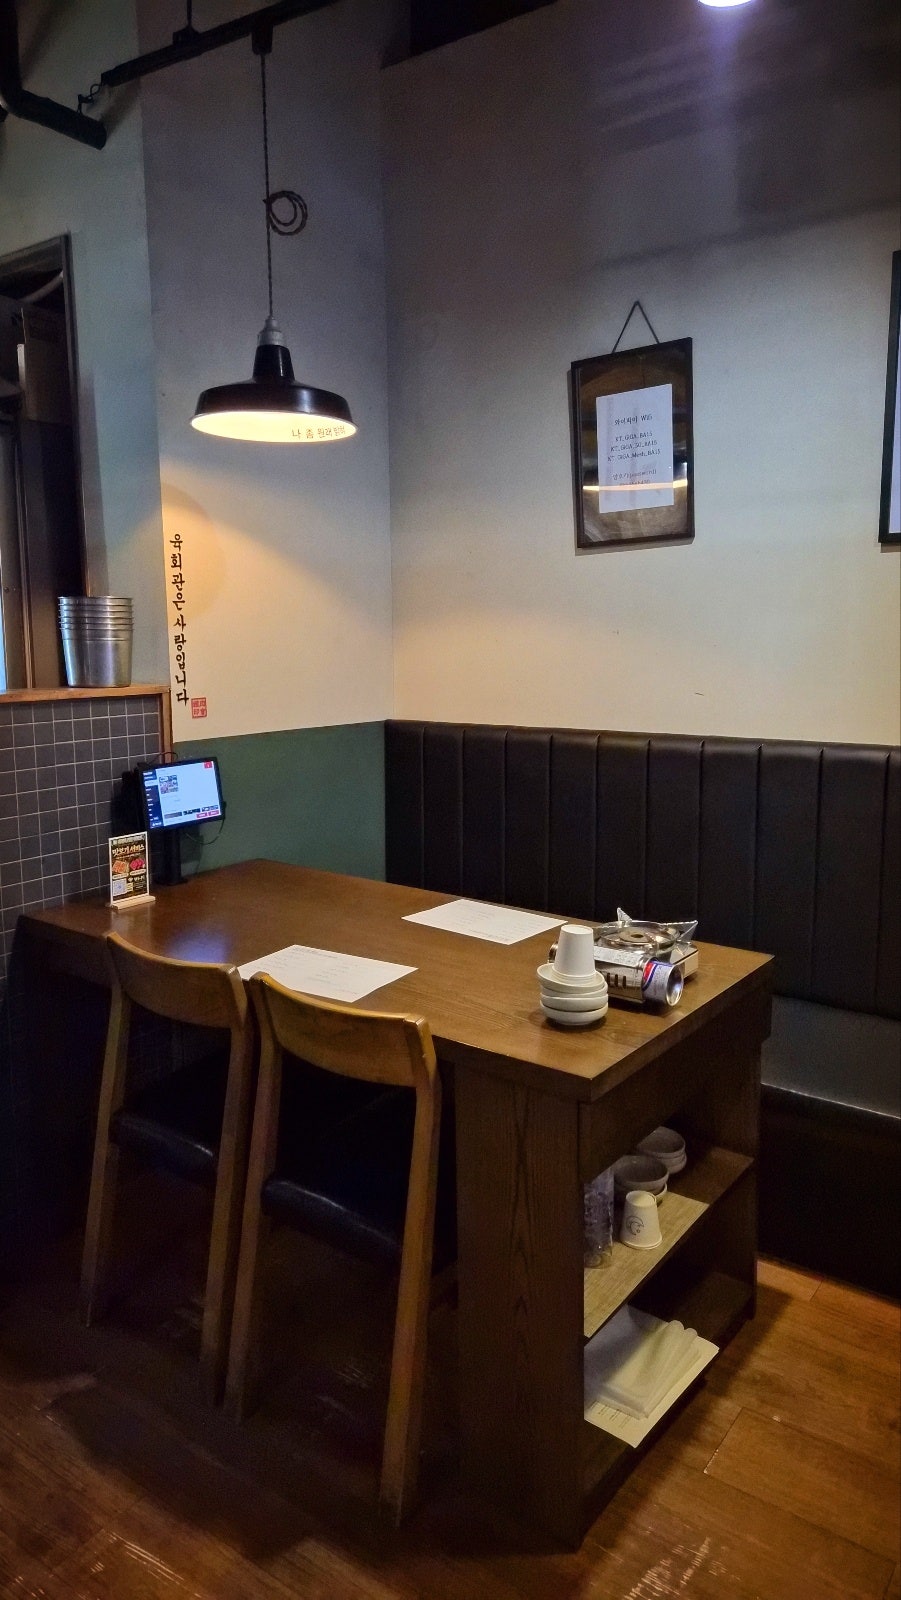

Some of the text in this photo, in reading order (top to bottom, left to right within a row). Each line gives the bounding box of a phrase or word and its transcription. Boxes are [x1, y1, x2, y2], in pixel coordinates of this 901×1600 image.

[291, 428, 301, 439] 나
[305, 427, 314, 439] 좀
[169, 533, 190, 707] 육회관은 사랑입니다
